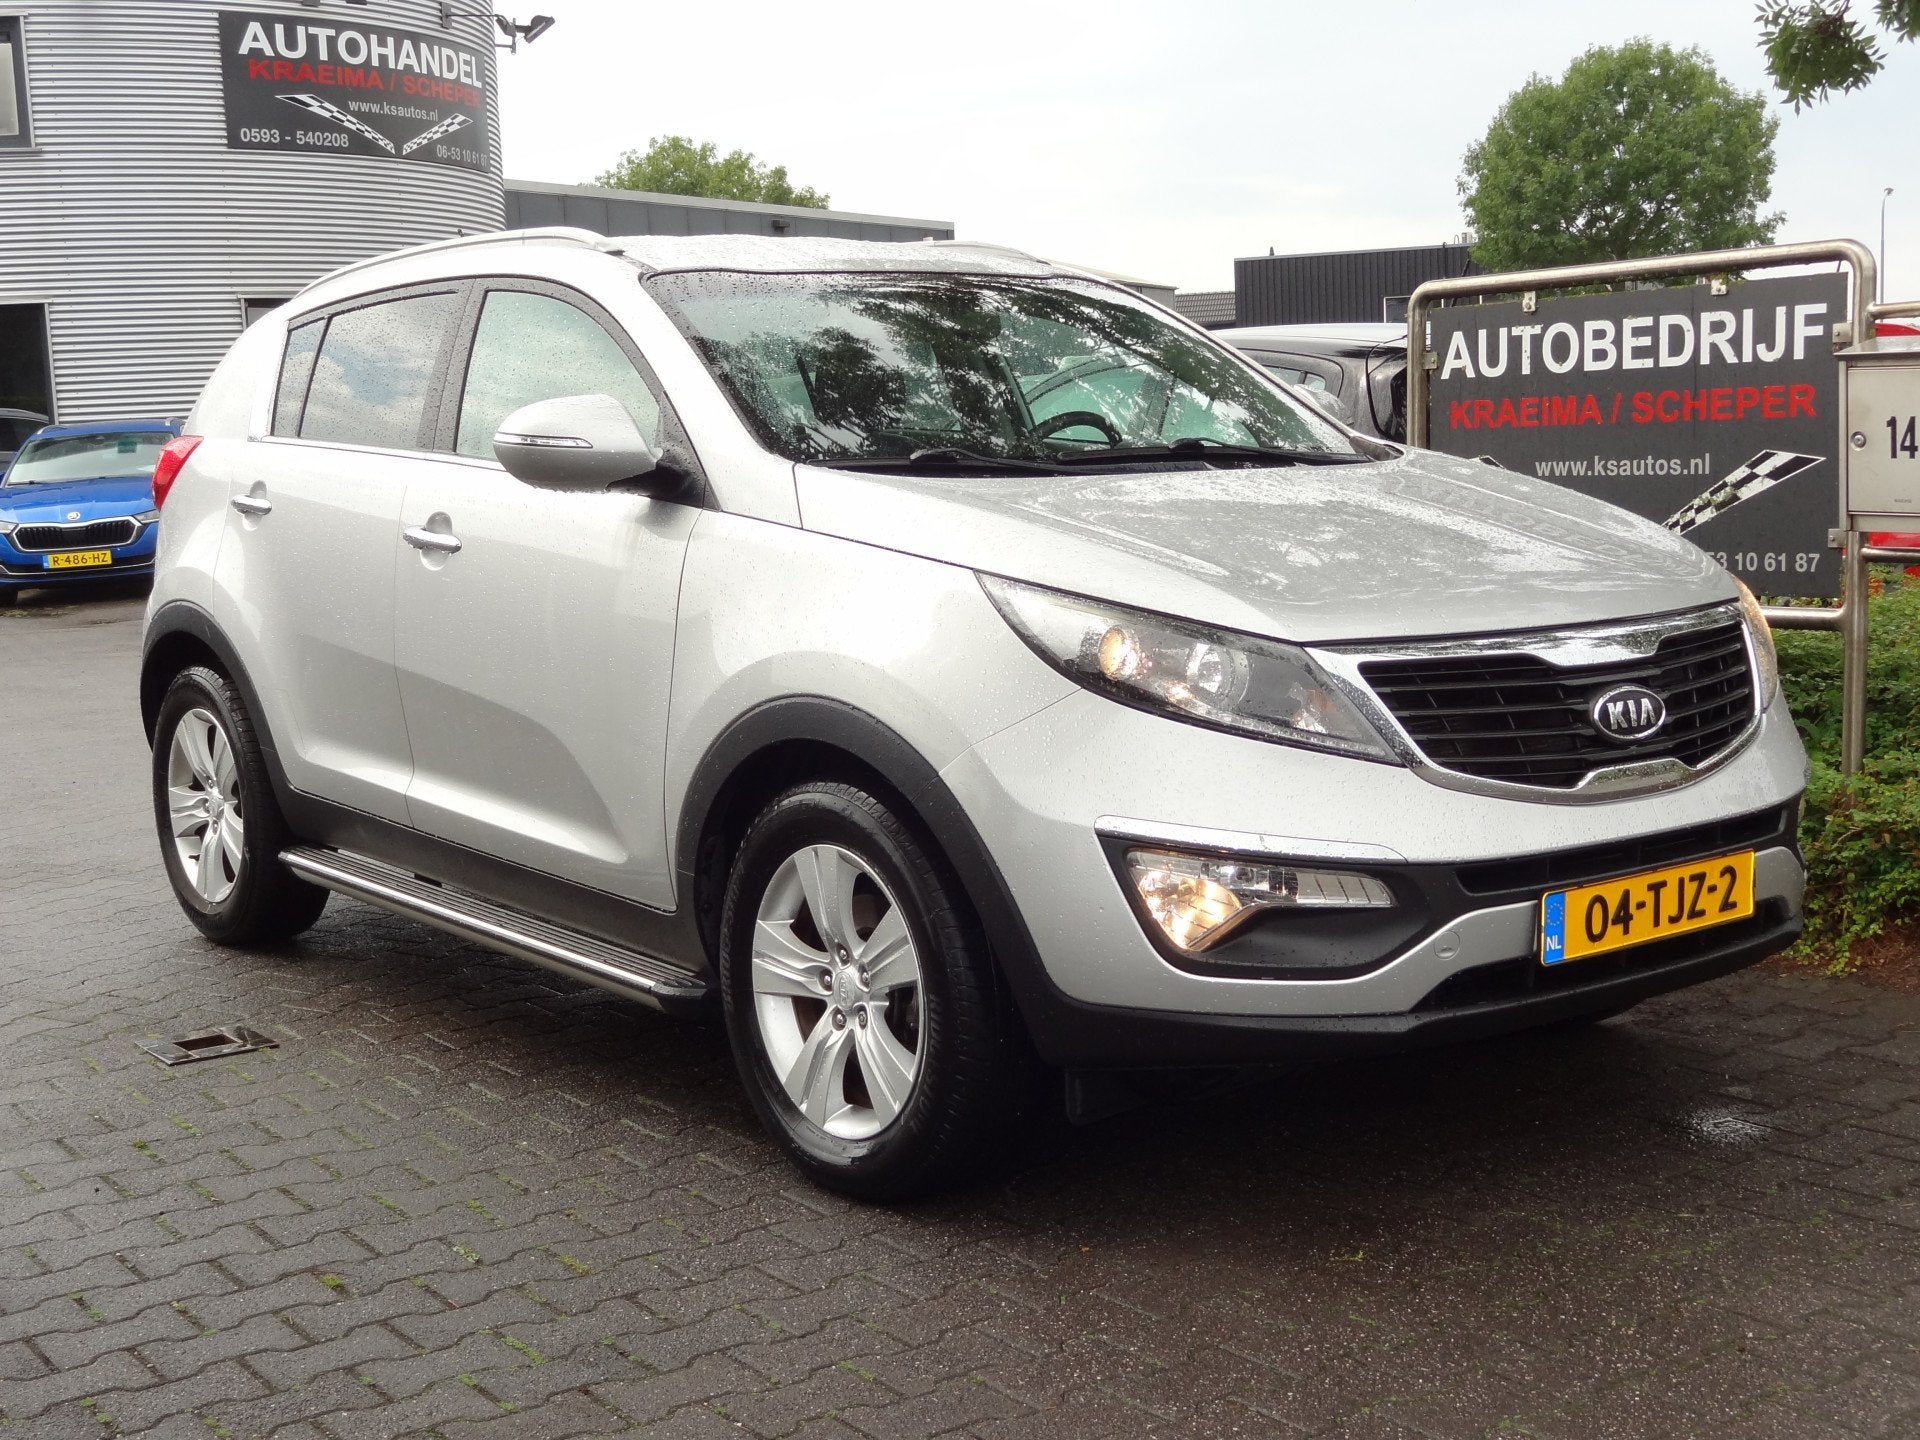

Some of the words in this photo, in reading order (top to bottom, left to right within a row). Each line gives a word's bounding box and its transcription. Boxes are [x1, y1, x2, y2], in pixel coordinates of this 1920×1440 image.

[238, 21, 482, 88] AUTOHANDEL
[249, 59, 384, 91] KRAEIMA
[390, 76, 397, 91] /
[403, 76, 480, 107] SCHEPER
[349, 101, 439, 122] www.ksautos.nl
[240, 128, 280, 144] 0593
[296, 131, 349, 147] 540208
[436, 144, 460, 161] 06-53
[463, 149, 471, 162] 10
[1441, 303, 1827, 380] AUTOBEDRIJF
[1450, 394, 1602, 430] KRAEIMA
[1610, 392, 1623, 424] /
[1631, 384, 1817, 424] SCHEPER
[1886, 416, 1919, 460] 14
[1535, 453, 1710, 477] www.ksautos.nl
[52, 552, 108, 566] R-486-HZ
[1734, 552, 1758, 571] 10
[1764, 552, 1786, 572] 61
[1795, 552, 1820, 572] 87
[1606, 697, 1656, 731] KIA
[1585, 865, 1738, 943] 04-TJZ-2
[1546, 935, 1562, 951] NL
